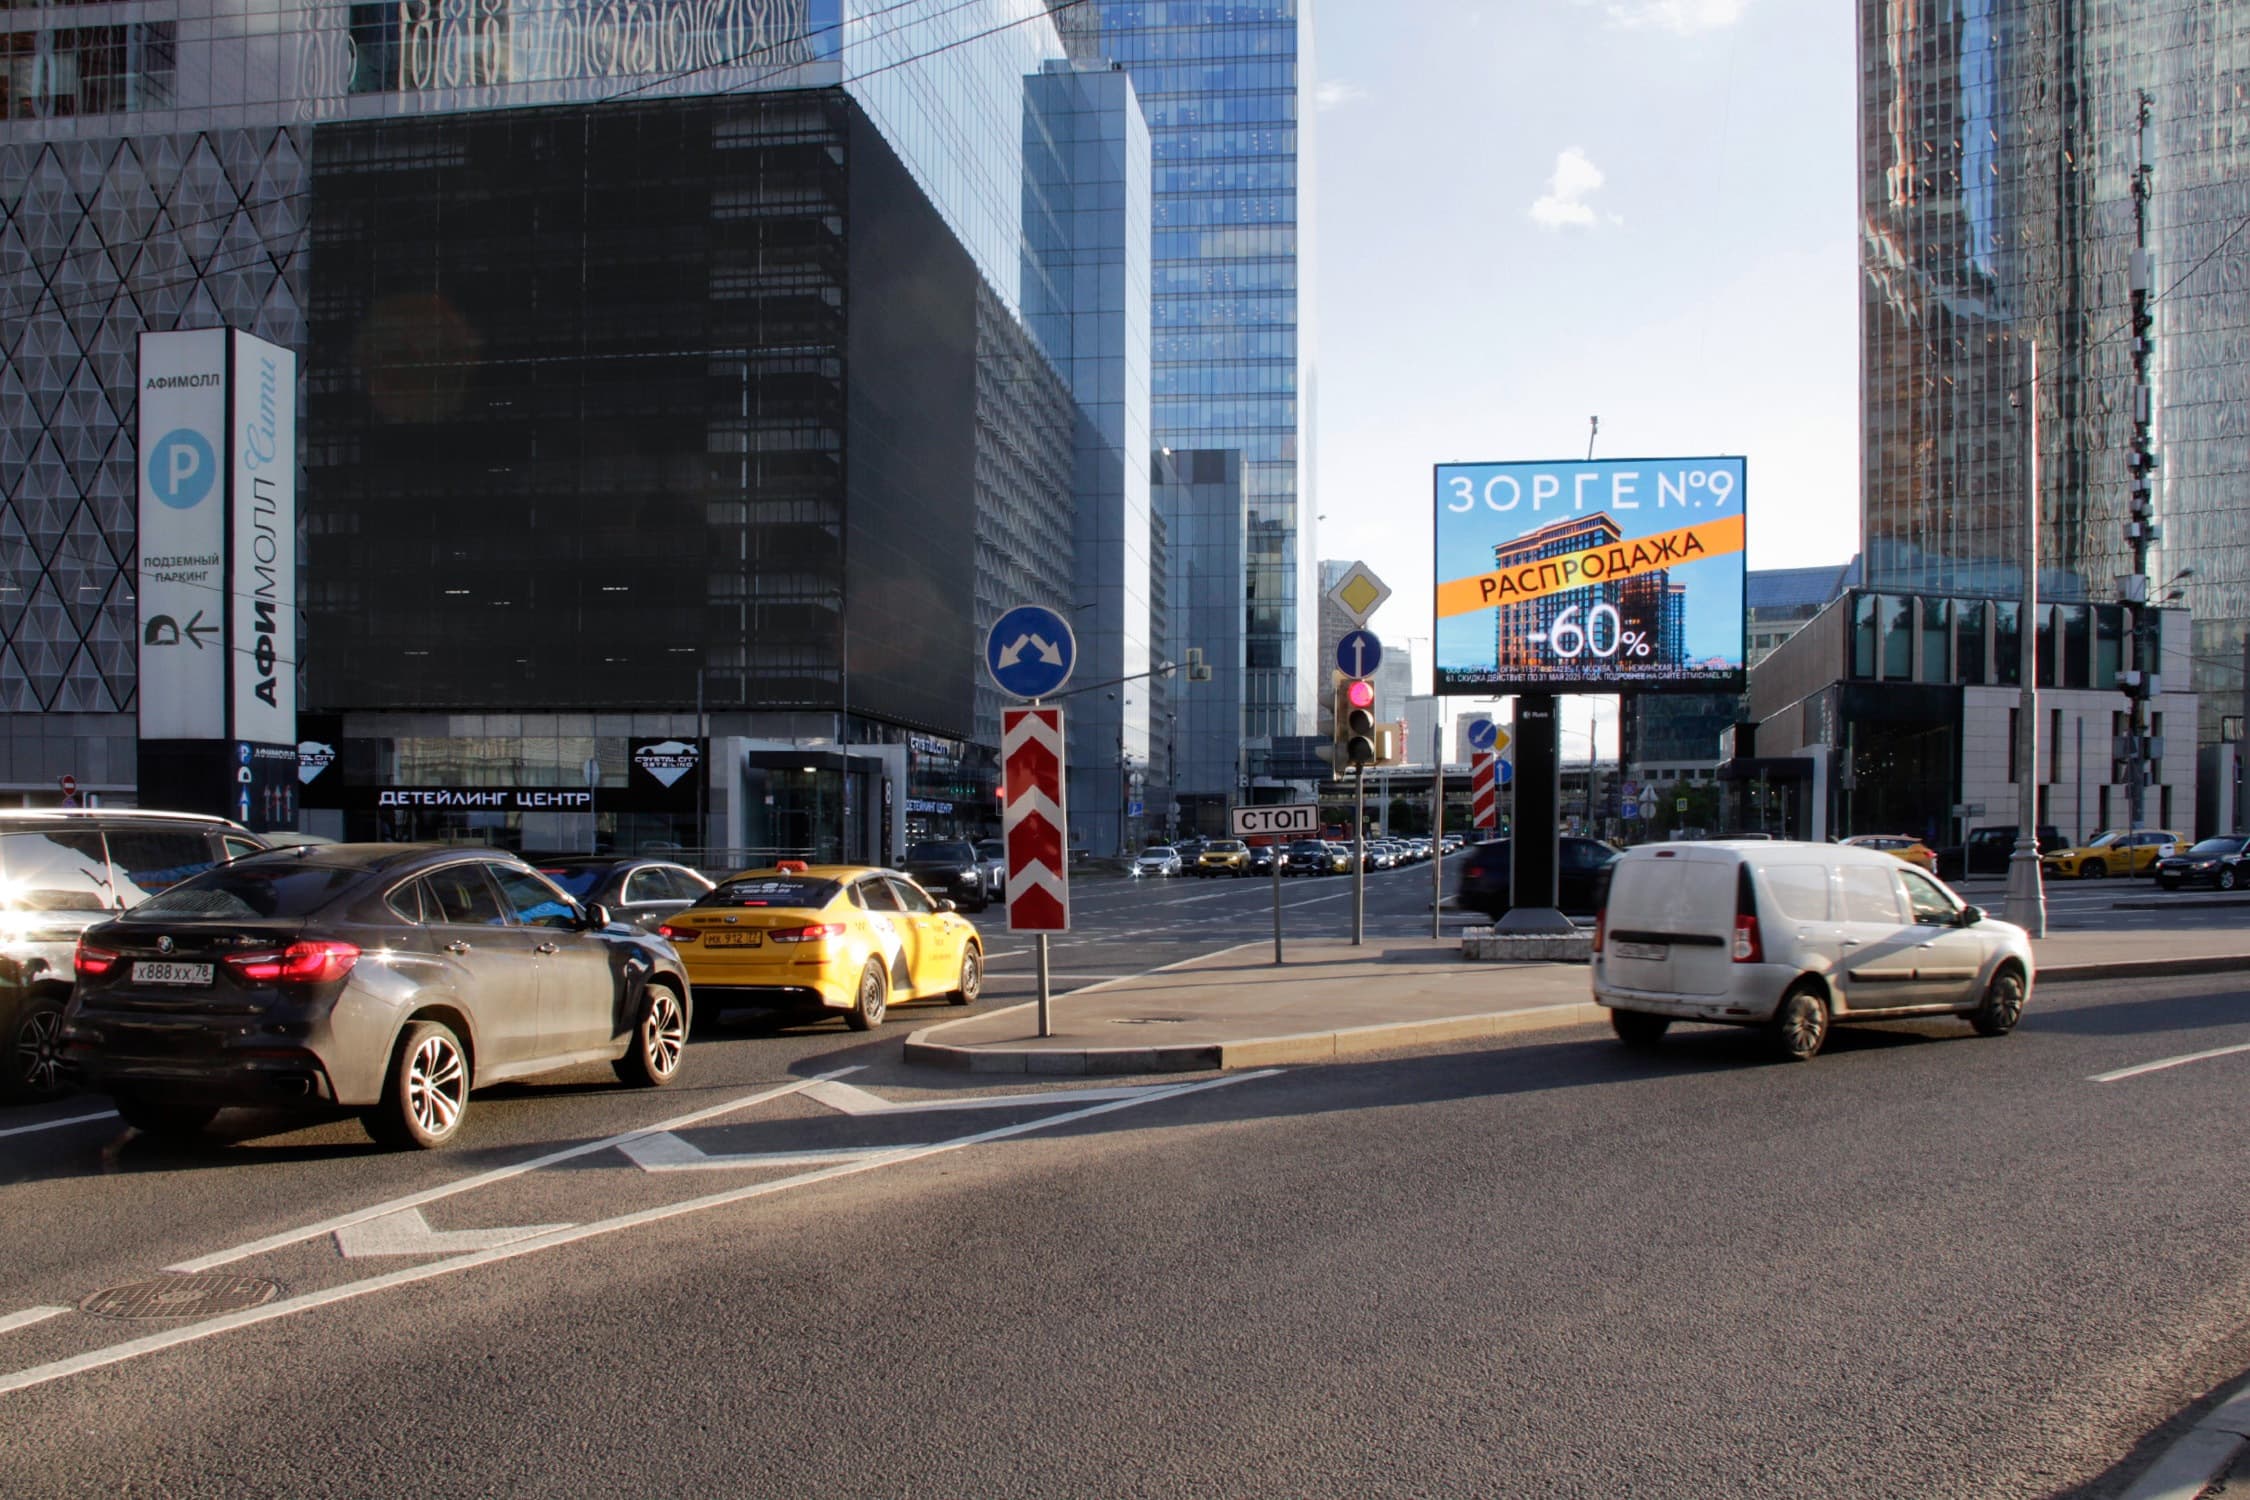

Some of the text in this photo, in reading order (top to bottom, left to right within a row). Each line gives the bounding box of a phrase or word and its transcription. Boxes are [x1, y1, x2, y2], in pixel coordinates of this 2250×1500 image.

[146, 374, 220, 389] АФИМОЛЛ
[168, 444, 200, 495] P
[1447, 471, 1640, 513] ЗОРГЕ
[144, 553, 220, 568] ПОДЗЕМНЫЙ
[1479, 530, 1705, 603] РАСПРОДАЖА
[155, 571, 208, 583] ПАРКИНГ
[254, 477, 277, 709] АФИМОЛЛ
[1527, 603, 1650, 658] -60%
[1458, 673, 1486, 683] СКИДКА
[378, 789, 590, 807] ДЕТЕЙЛИНГ ЦЕНТР
[1241, 809, 1308, 830] СТОП
